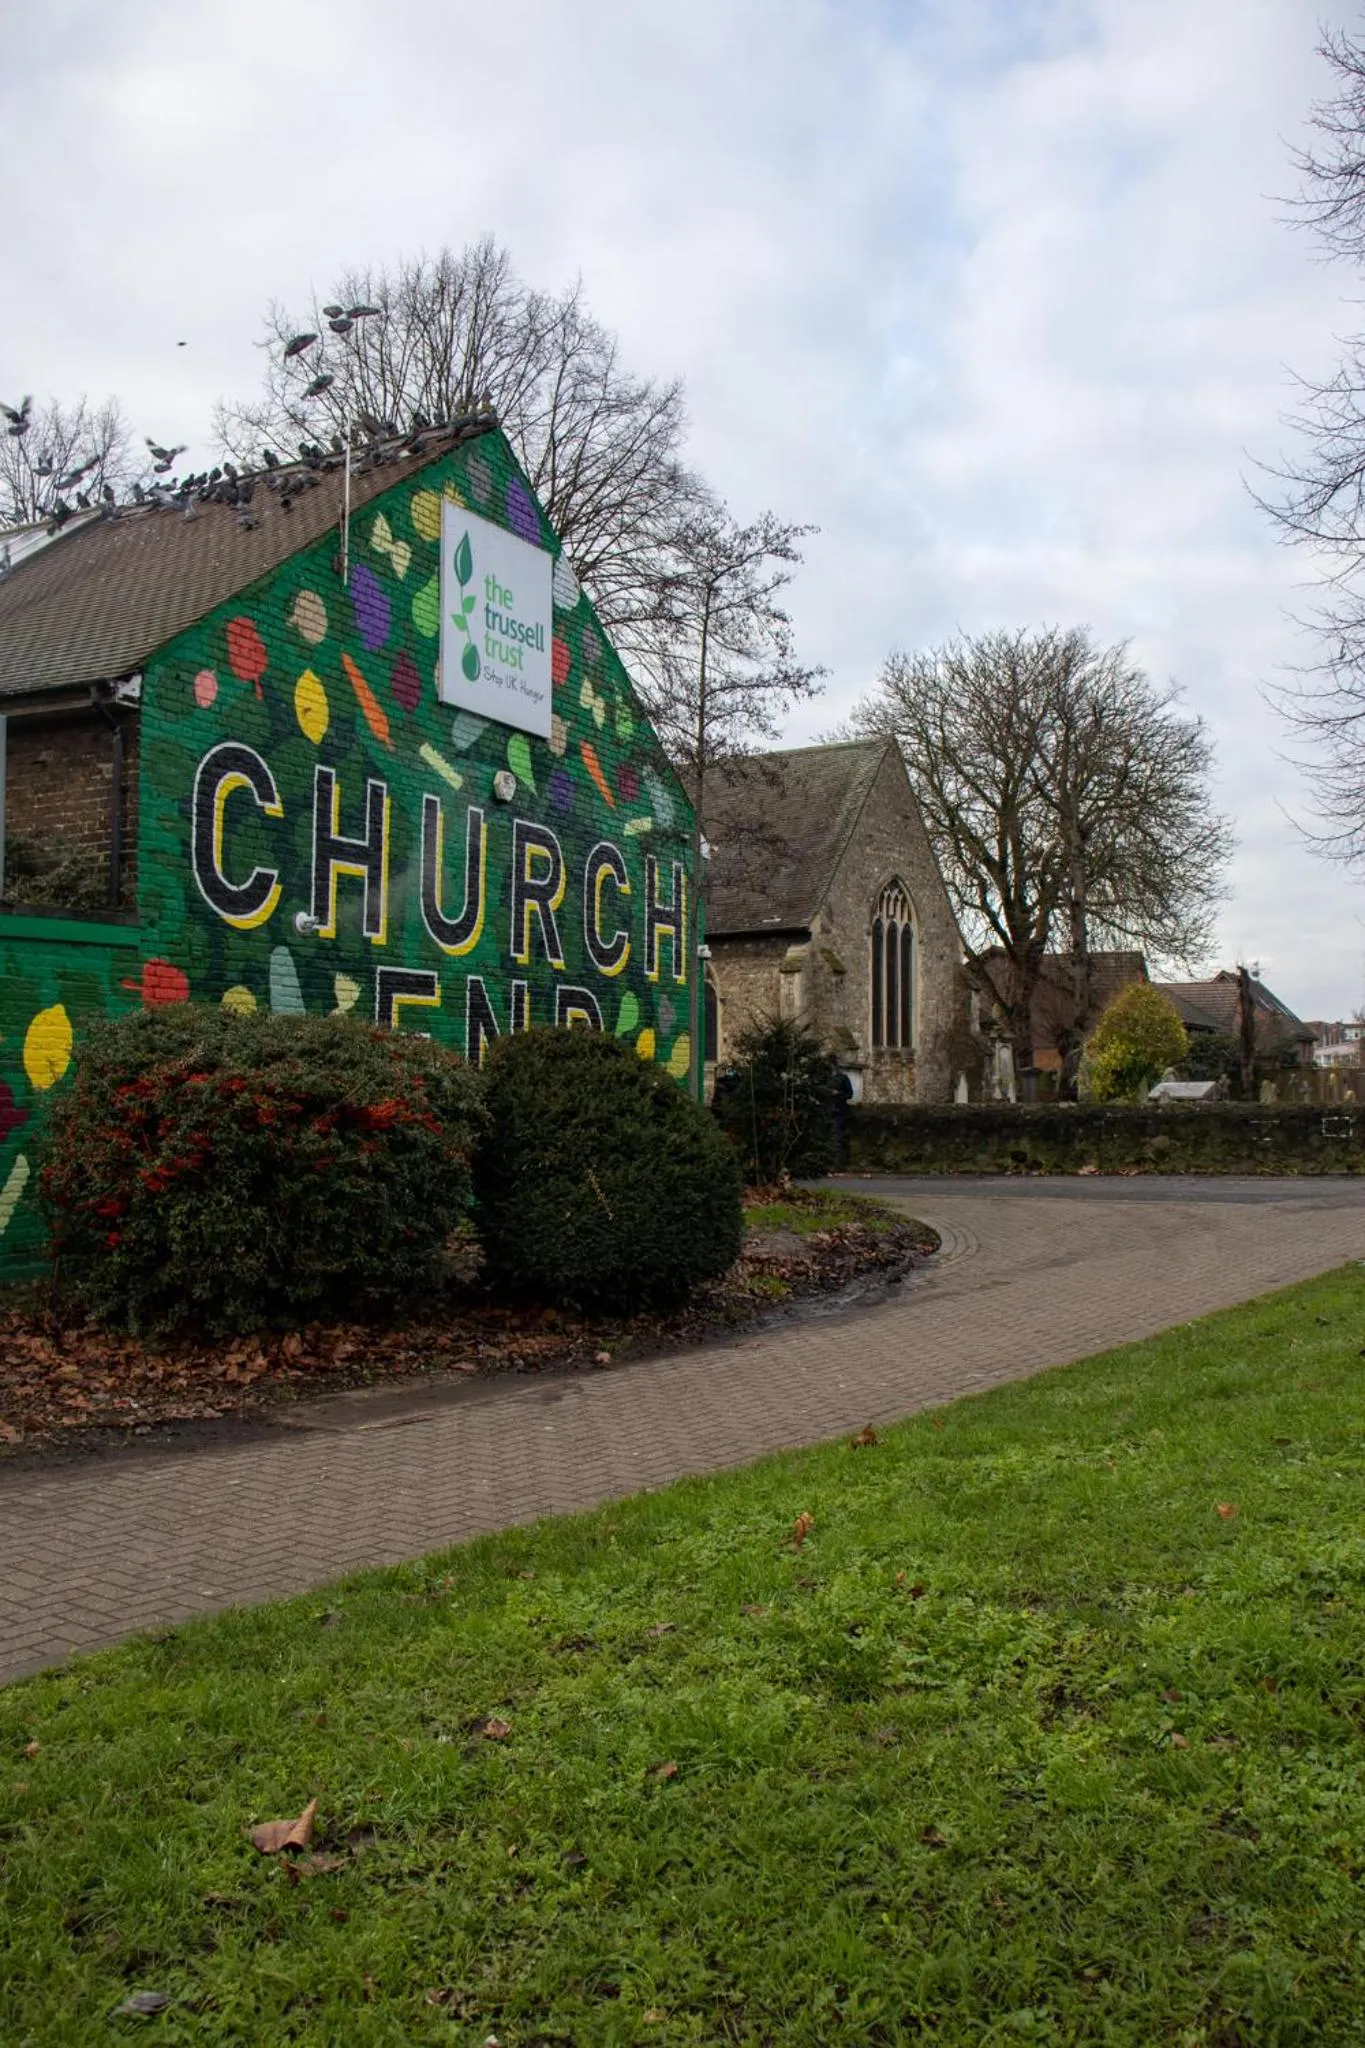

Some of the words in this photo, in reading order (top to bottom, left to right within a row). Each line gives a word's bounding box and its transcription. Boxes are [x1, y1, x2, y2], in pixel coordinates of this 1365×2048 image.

[484, 573, 513, 611] the
[484, 603, 544, 653] trussell
[484, 632, 524, 671] trust
[192, 741, 687, 985] CHURCH
